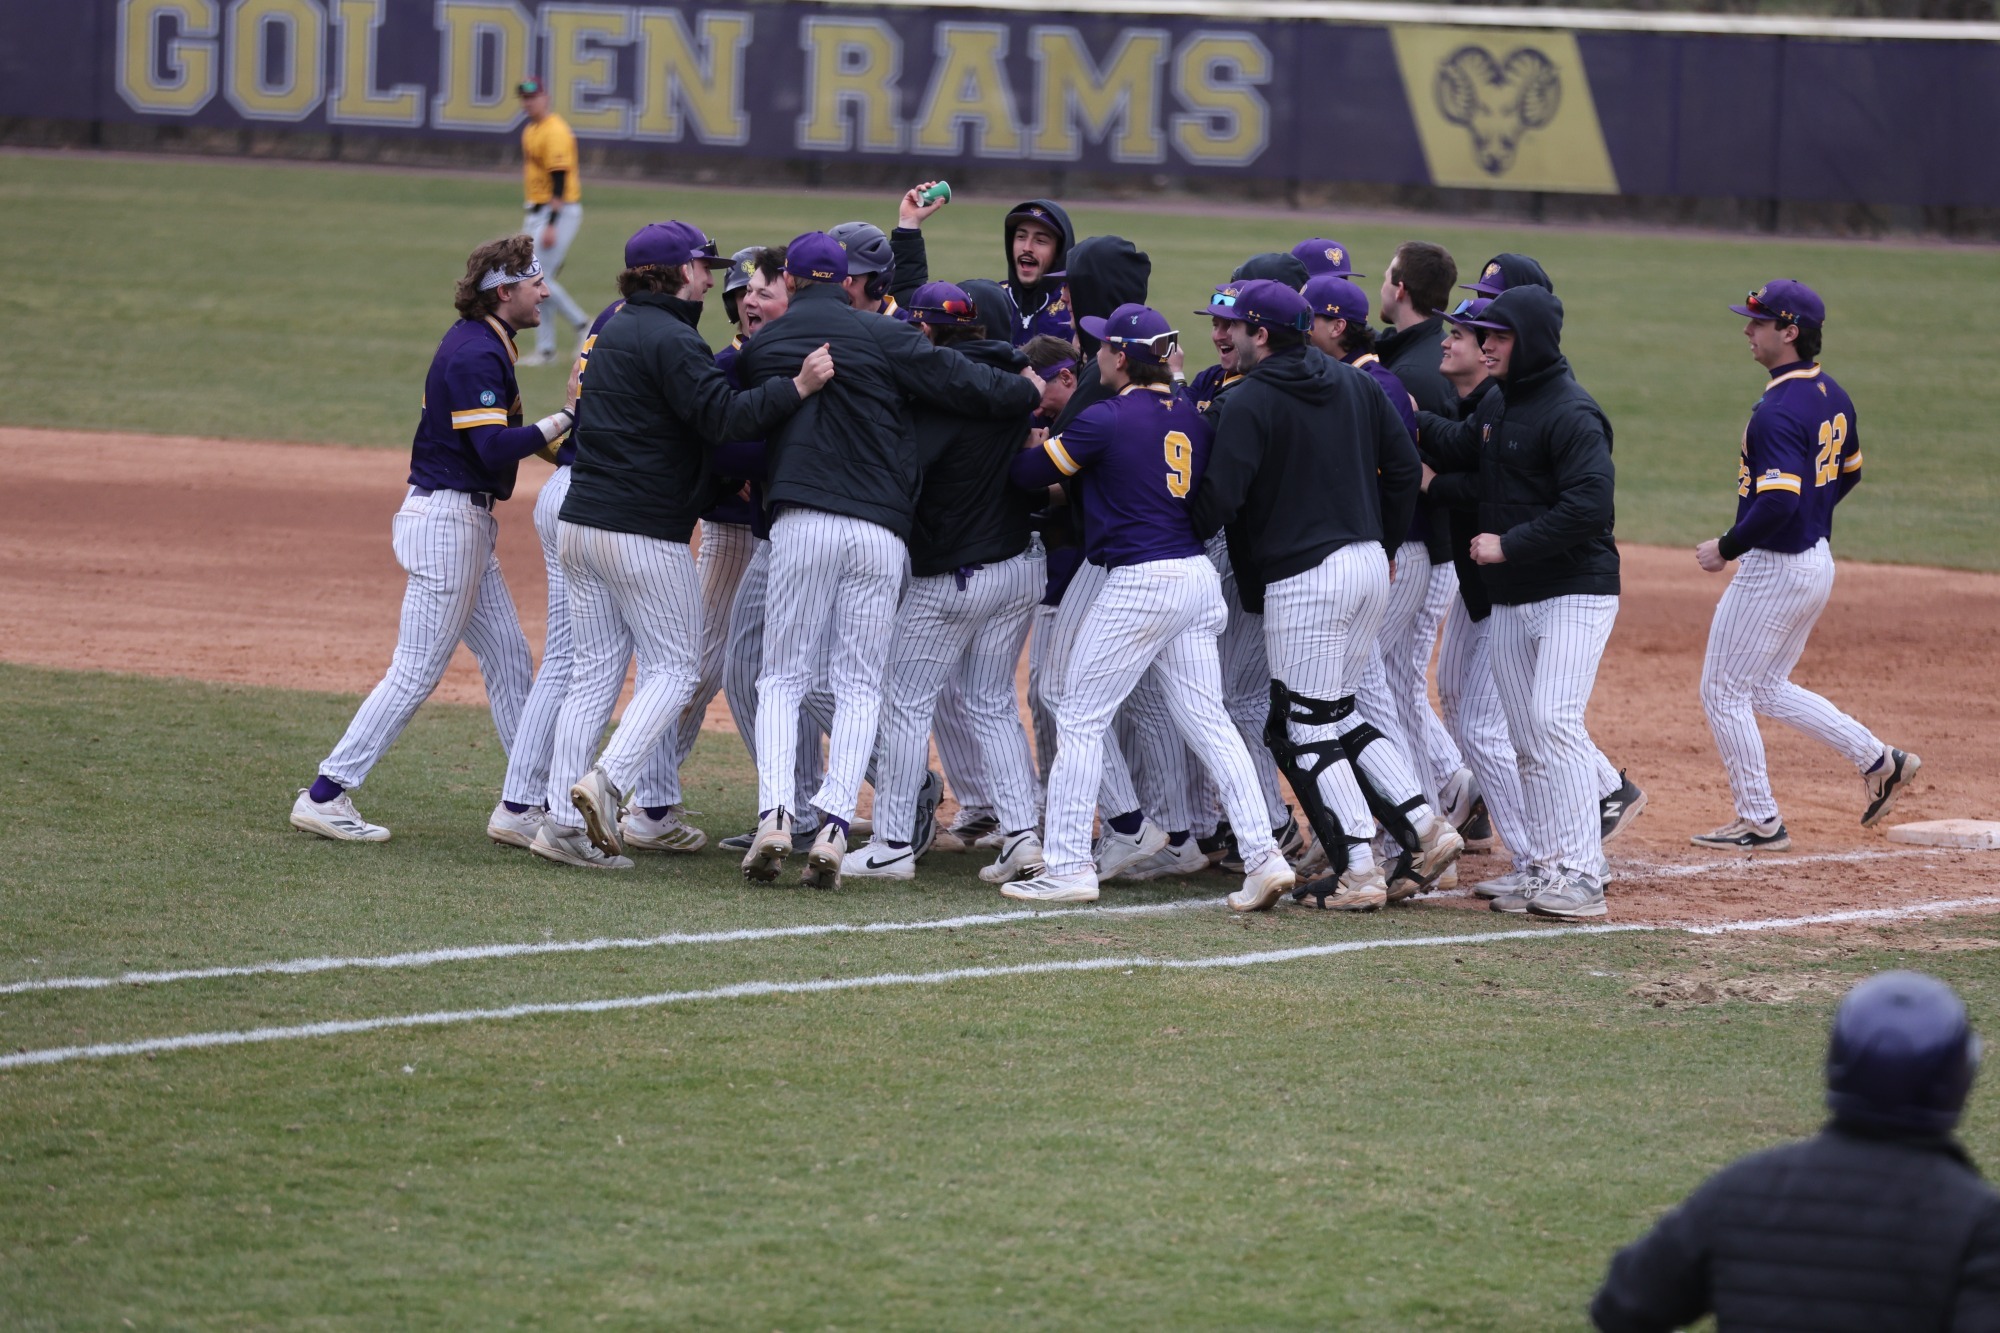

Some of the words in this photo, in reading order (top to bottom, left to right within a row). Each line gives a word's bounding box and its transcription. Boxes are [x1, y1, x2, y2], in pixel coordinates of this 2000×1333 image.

[116, 0, 752, 146] GOLDEN
[796, 15, 1273, 167] RAMS
[1164, 430, 1192, 499] 9
[1815, 412, 1848, 487] 22
